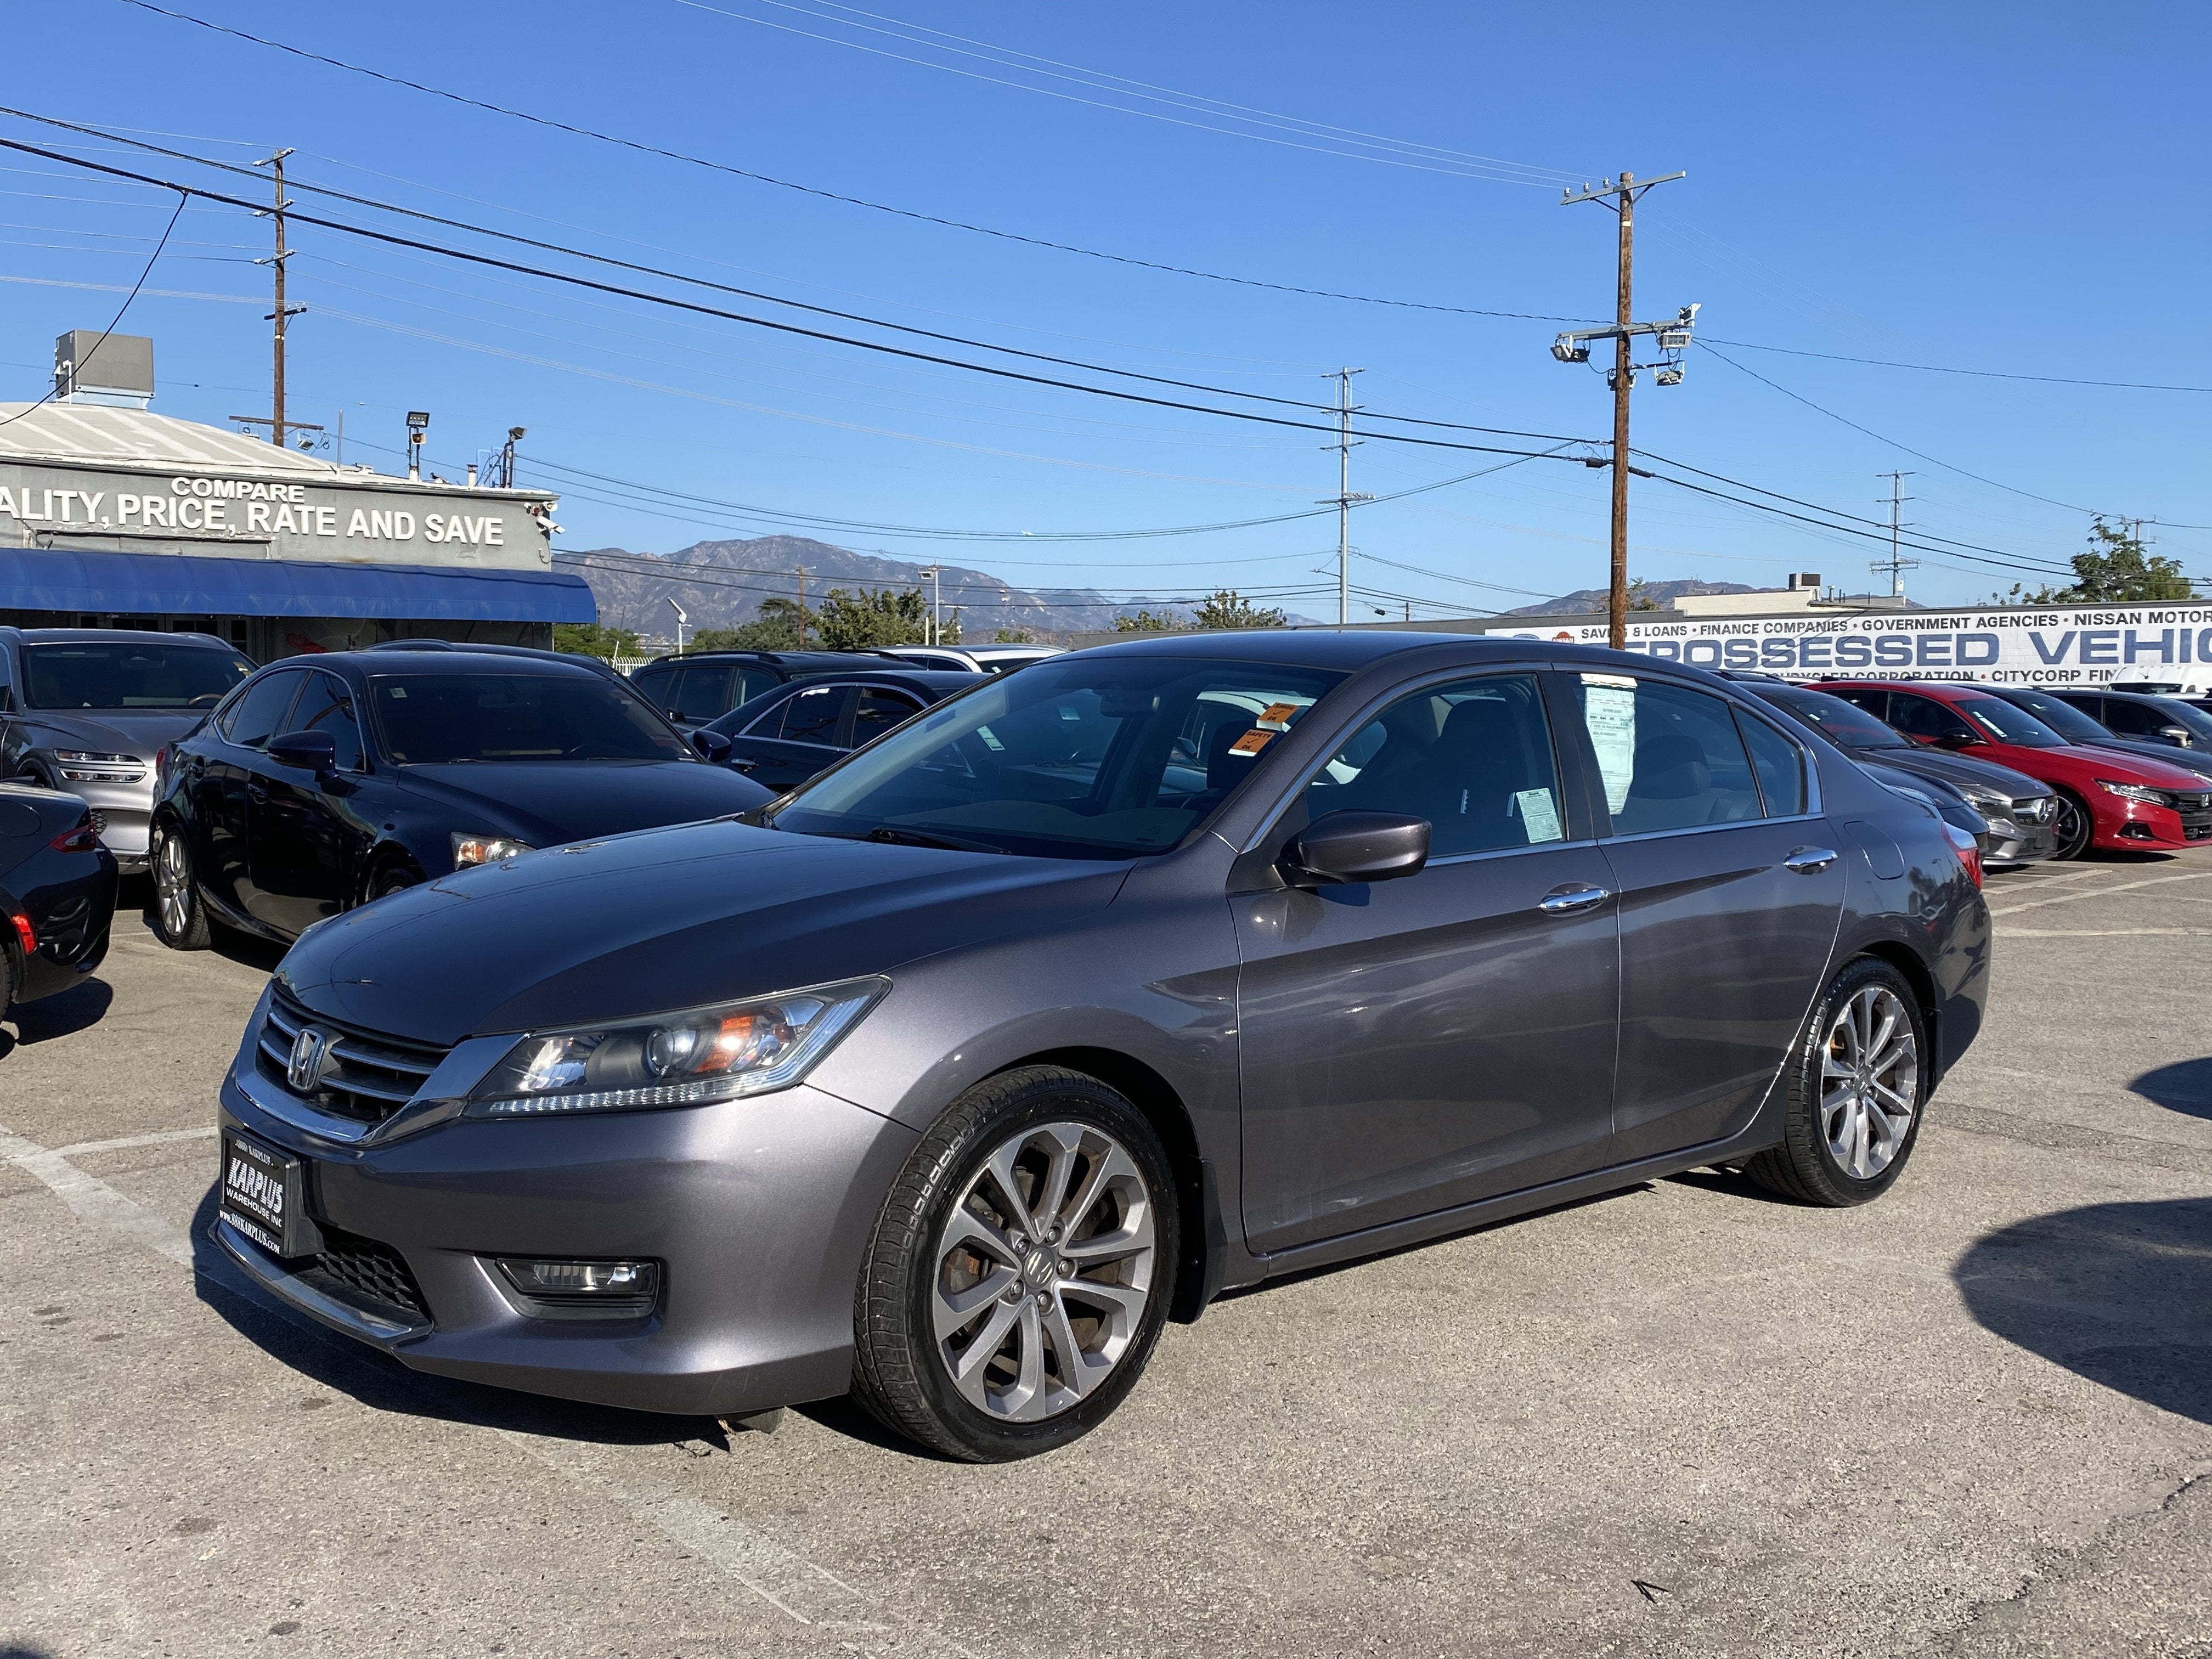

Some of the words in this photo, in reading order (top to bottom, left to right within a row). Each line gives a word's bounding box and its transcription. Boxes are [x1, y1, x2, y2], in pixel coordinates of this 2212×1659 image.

[171, 477, 305, 503] COMPARE
[0, 486, 110, 529] ALITY,
[117, 493, 236, 537] PRICE,
[247, 501, 337, 536] RATE
[347, 508, 416, 540] AND
[424, 514, 504, 546] SAVE
[1633, 627, 1641, 637] &
[1645, 625, 1688, 637] LOANS
[1700, 623, 1759, 635] FINANCE
[1764, 620, 1848, 634] COMPANIES
[1862, 617, 1971, 630] GOVERNMENT
[1976, 614, 2059, 628] AGENCIES
[2074, 612, 2142, 625] NISSAN
[2148, 610, 2212, 624] MOTOR
[1583, 633, 2000, 668] POSSESSED
[1991, 670, 2081, 682] CITYCORP
[227, 1158, 283, 1214] KARPLUS
[226, 1187, 270, 1220] WAREHOUSE
